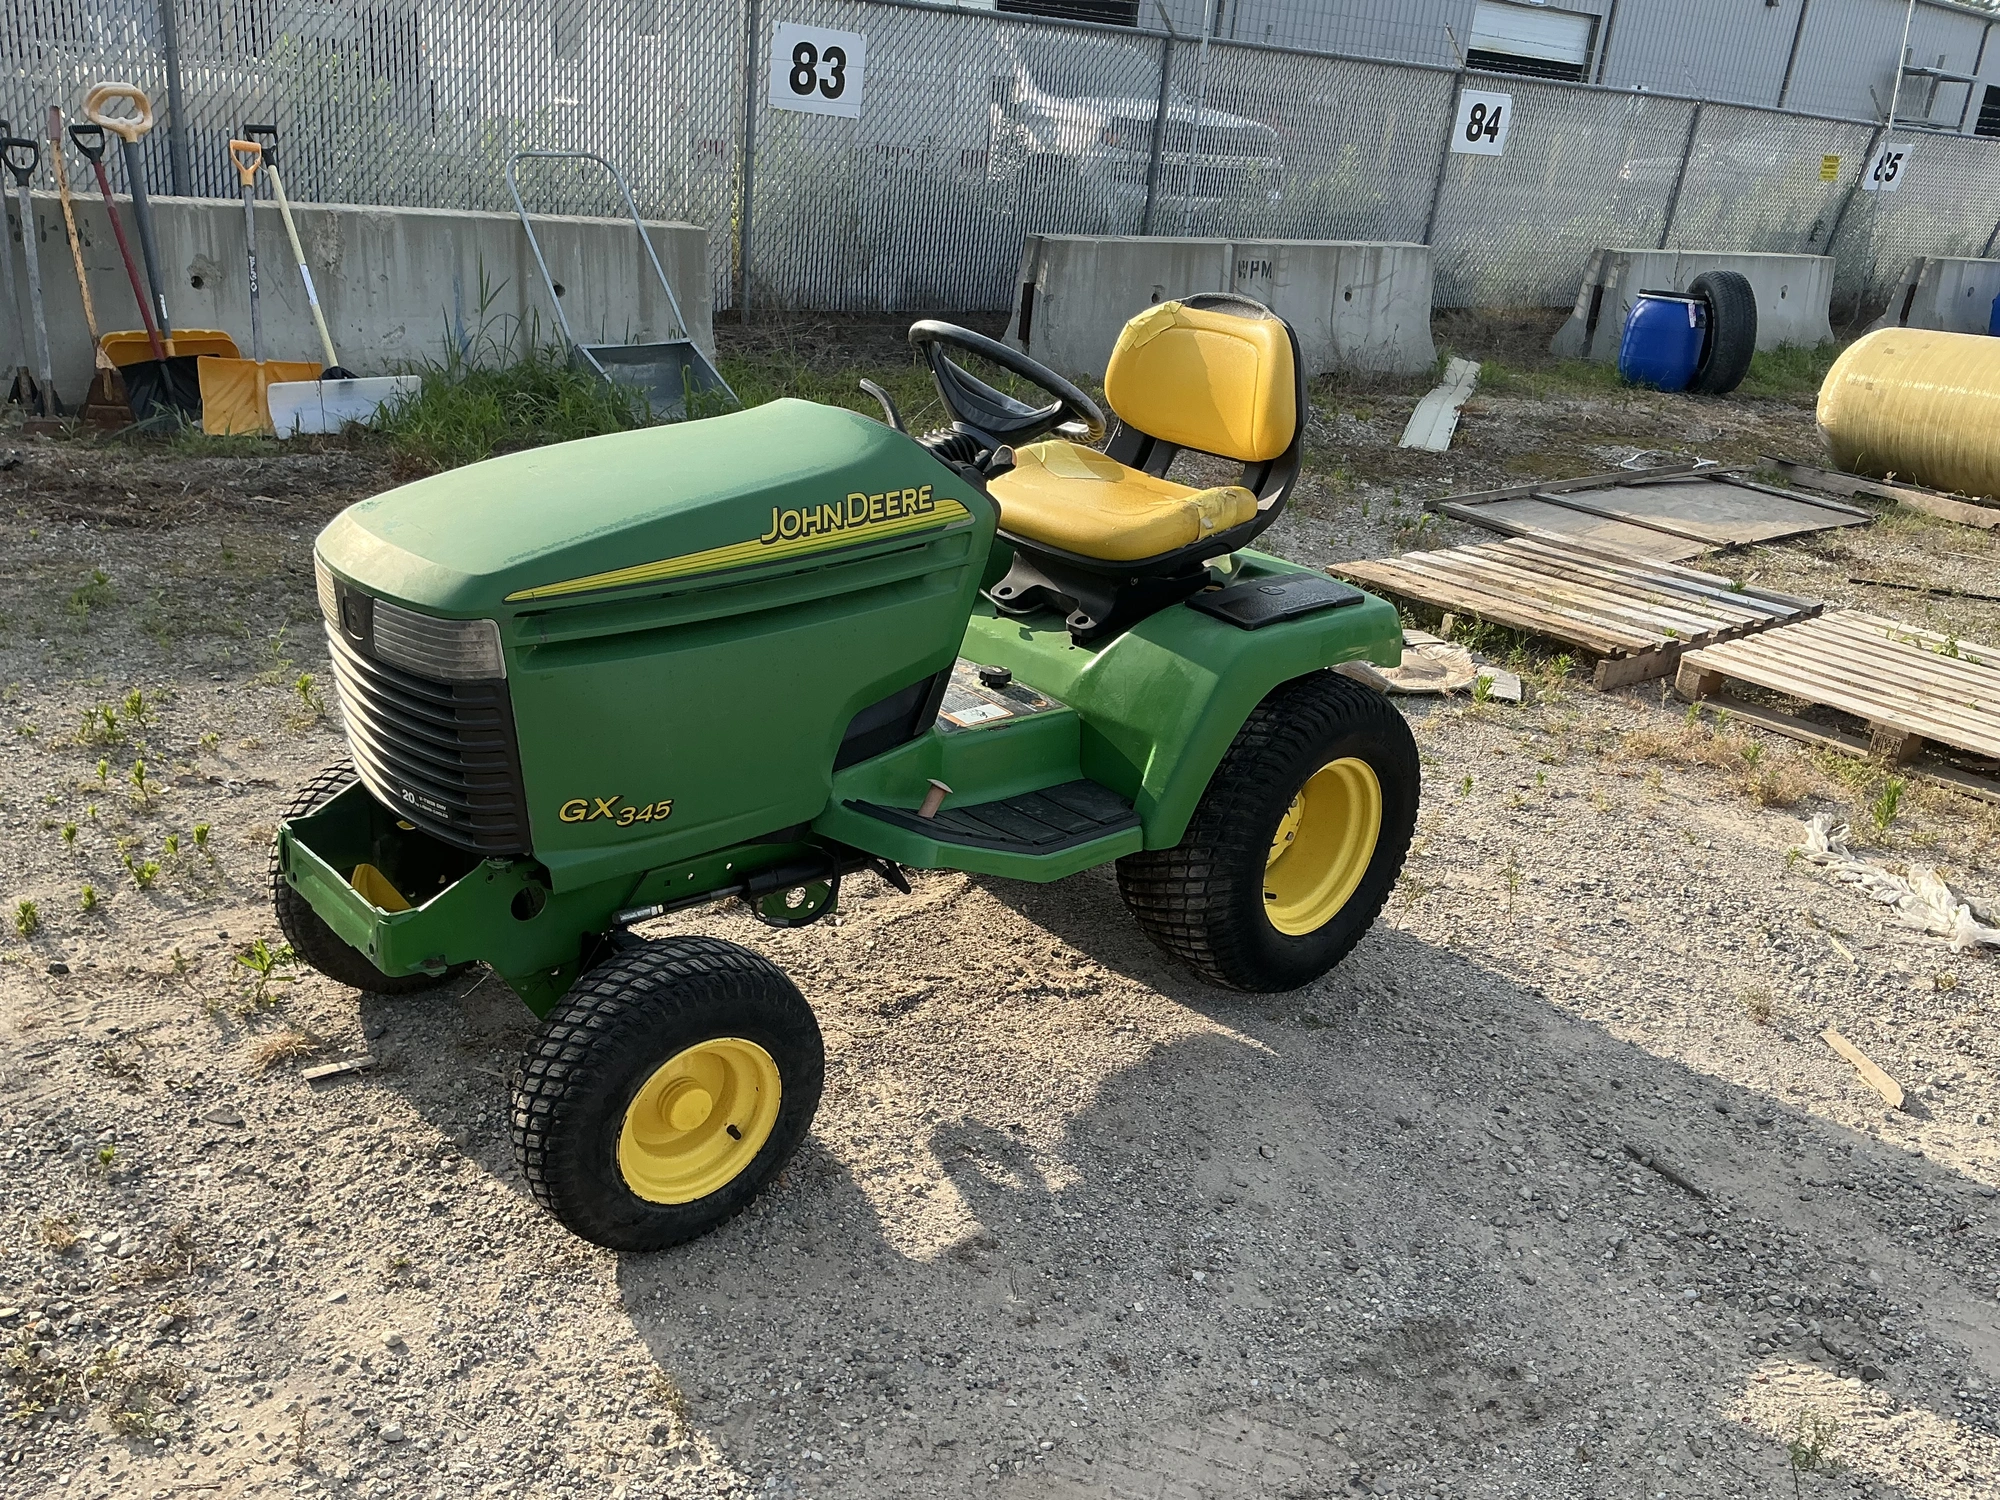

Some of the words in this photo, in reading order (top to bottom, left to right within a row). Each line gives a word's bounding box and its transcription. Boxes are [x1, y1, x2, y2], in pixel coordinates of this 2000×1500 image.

[789, 41, 847, 99] 83
[1466, 102, 1502, 143] 84
[761, 502, 844, 545] JOHN
[846, 484, 934, 527] DEERE
[402, 788, 415, 804] 20
